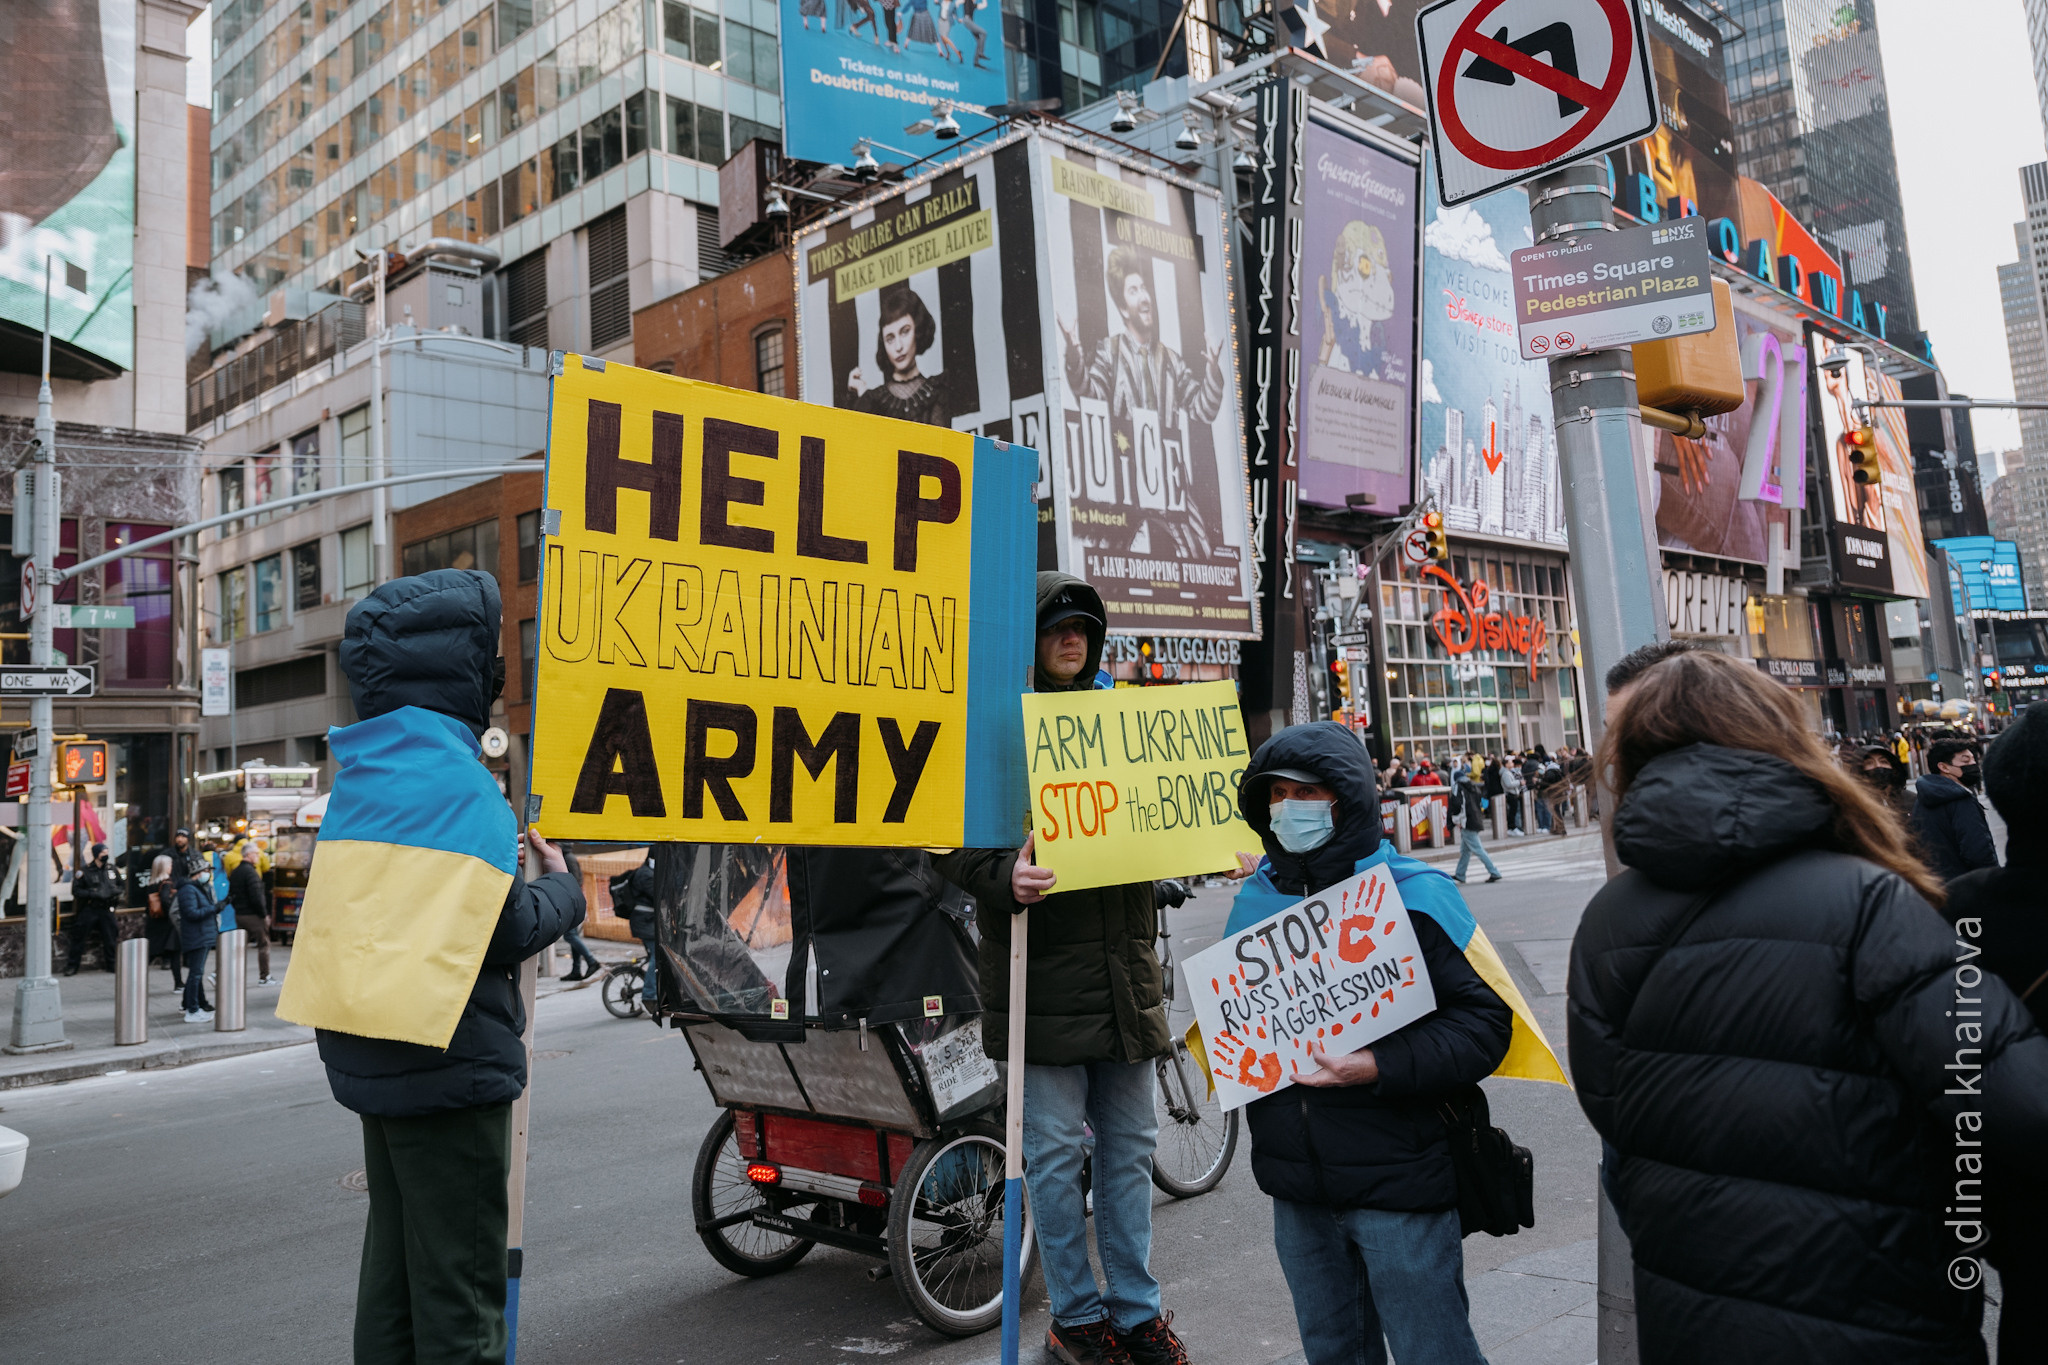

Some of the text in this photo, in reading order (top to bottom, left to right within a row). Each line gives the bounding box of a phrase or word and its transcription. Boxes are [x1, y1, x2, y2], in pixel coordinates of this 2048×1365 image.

[839, 56, 960, 92] Tickets on sale now!
[1061, 167, 1148, 217] RAISING SPIRITS
[1449, 190, 1466, 201] R3-2
[809, 181, 974, 275] TIMES SQUARE CAN REALLY
[1116, 217, 1196, 260] ON BROADWAY!
[1668, 223, 1694, 236] NYC
[1669, 233, 1696, 243] PLAZA
[841, 217, 989, 294] MAKE YOU FEEL ALIVE!
[1520, 243, 1593, 263] OPEN TO PUBLIC
[1523, 254, 1674, 293] Times Square
[1445, 269, 1509, 308] WELCOME
[1526, 274, 1700, 316] Pedestrian Plaza
[1486, 314, 1513, 337] store
[1453, 329, 1487, 356] VISIT
[1354, 386, 1397, 411] WORMHOLE
[584, 398, 962, 573] HELP
[1070, 508, 1128, 528] The Musical.
[1845, 536, 1884, 560] JOHN HARDY
[1102, 556, 1180, 582] JAW-DROPPING
[89, 608, 98, 625] 7
[1106, 601, 1120, 613] THIS
[1120, 602, 1134, 614] WAY
[1134, 603, 1143, 614] TO
[1143, 603, 1154, 615] THE
[1154, 604, 1194, 618] NETHERWORLD
[1221, 608, 1249, 620] BROADWAY
[1667, 571, 1749, 635] OREVER
[545, 545, 957, 694] UKRAINIAN
[1101, 635, 1242, 665] FTS LUGGAGE
[4, 676, 79, 687] ONE WAY
[1145, 663, 1182, 679] I NY
[1768, 661, 1780, 676] U.S.
[1780, 661, 1798, 676] POLO
[1033, 704, 1246, 773] ARM UKRAINE
[568, 686, 943, 825] ARMY
[1040, 781, 1119, 842] STOP
[1125, 786, 1161, 833] the
[1235, 900, 1330, 987] STOP
[1271, 957, 1402, 1046] AGGRESSION
[944, 1032, 977, 1059] 5 PER
[938, 1074, 959, 1092] RIDE
